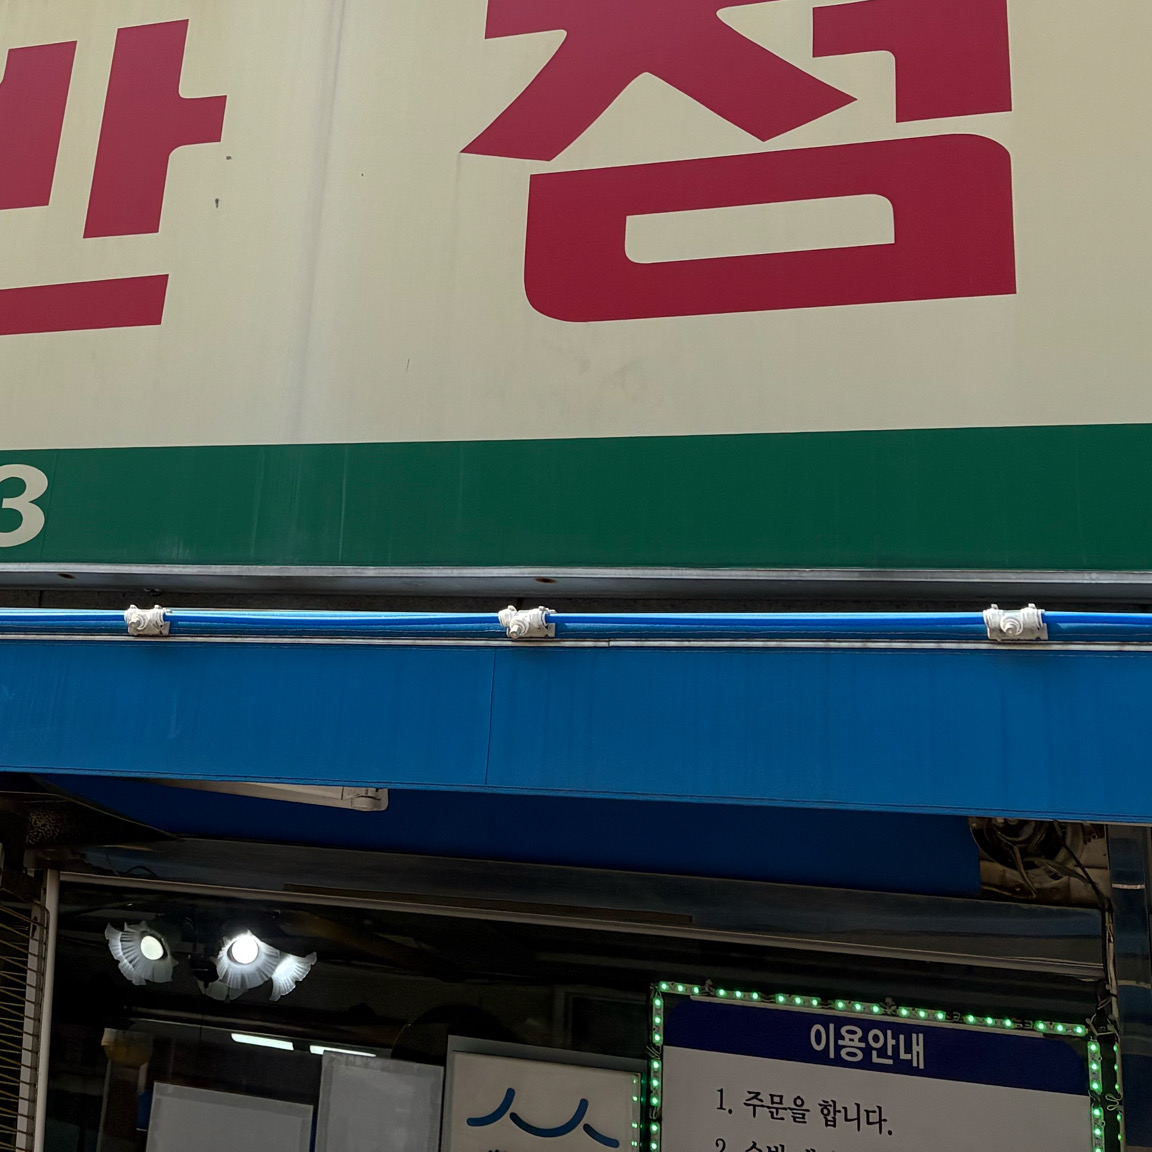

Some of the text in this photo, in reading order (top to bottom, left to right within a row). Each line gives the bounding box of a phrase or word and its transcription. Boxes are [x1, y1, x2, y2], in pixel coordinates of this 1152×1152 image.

[810, 1023, 925, 1069] 이용안내
[716, 1088, 894, 1137] 1. 주문을 합니다.
